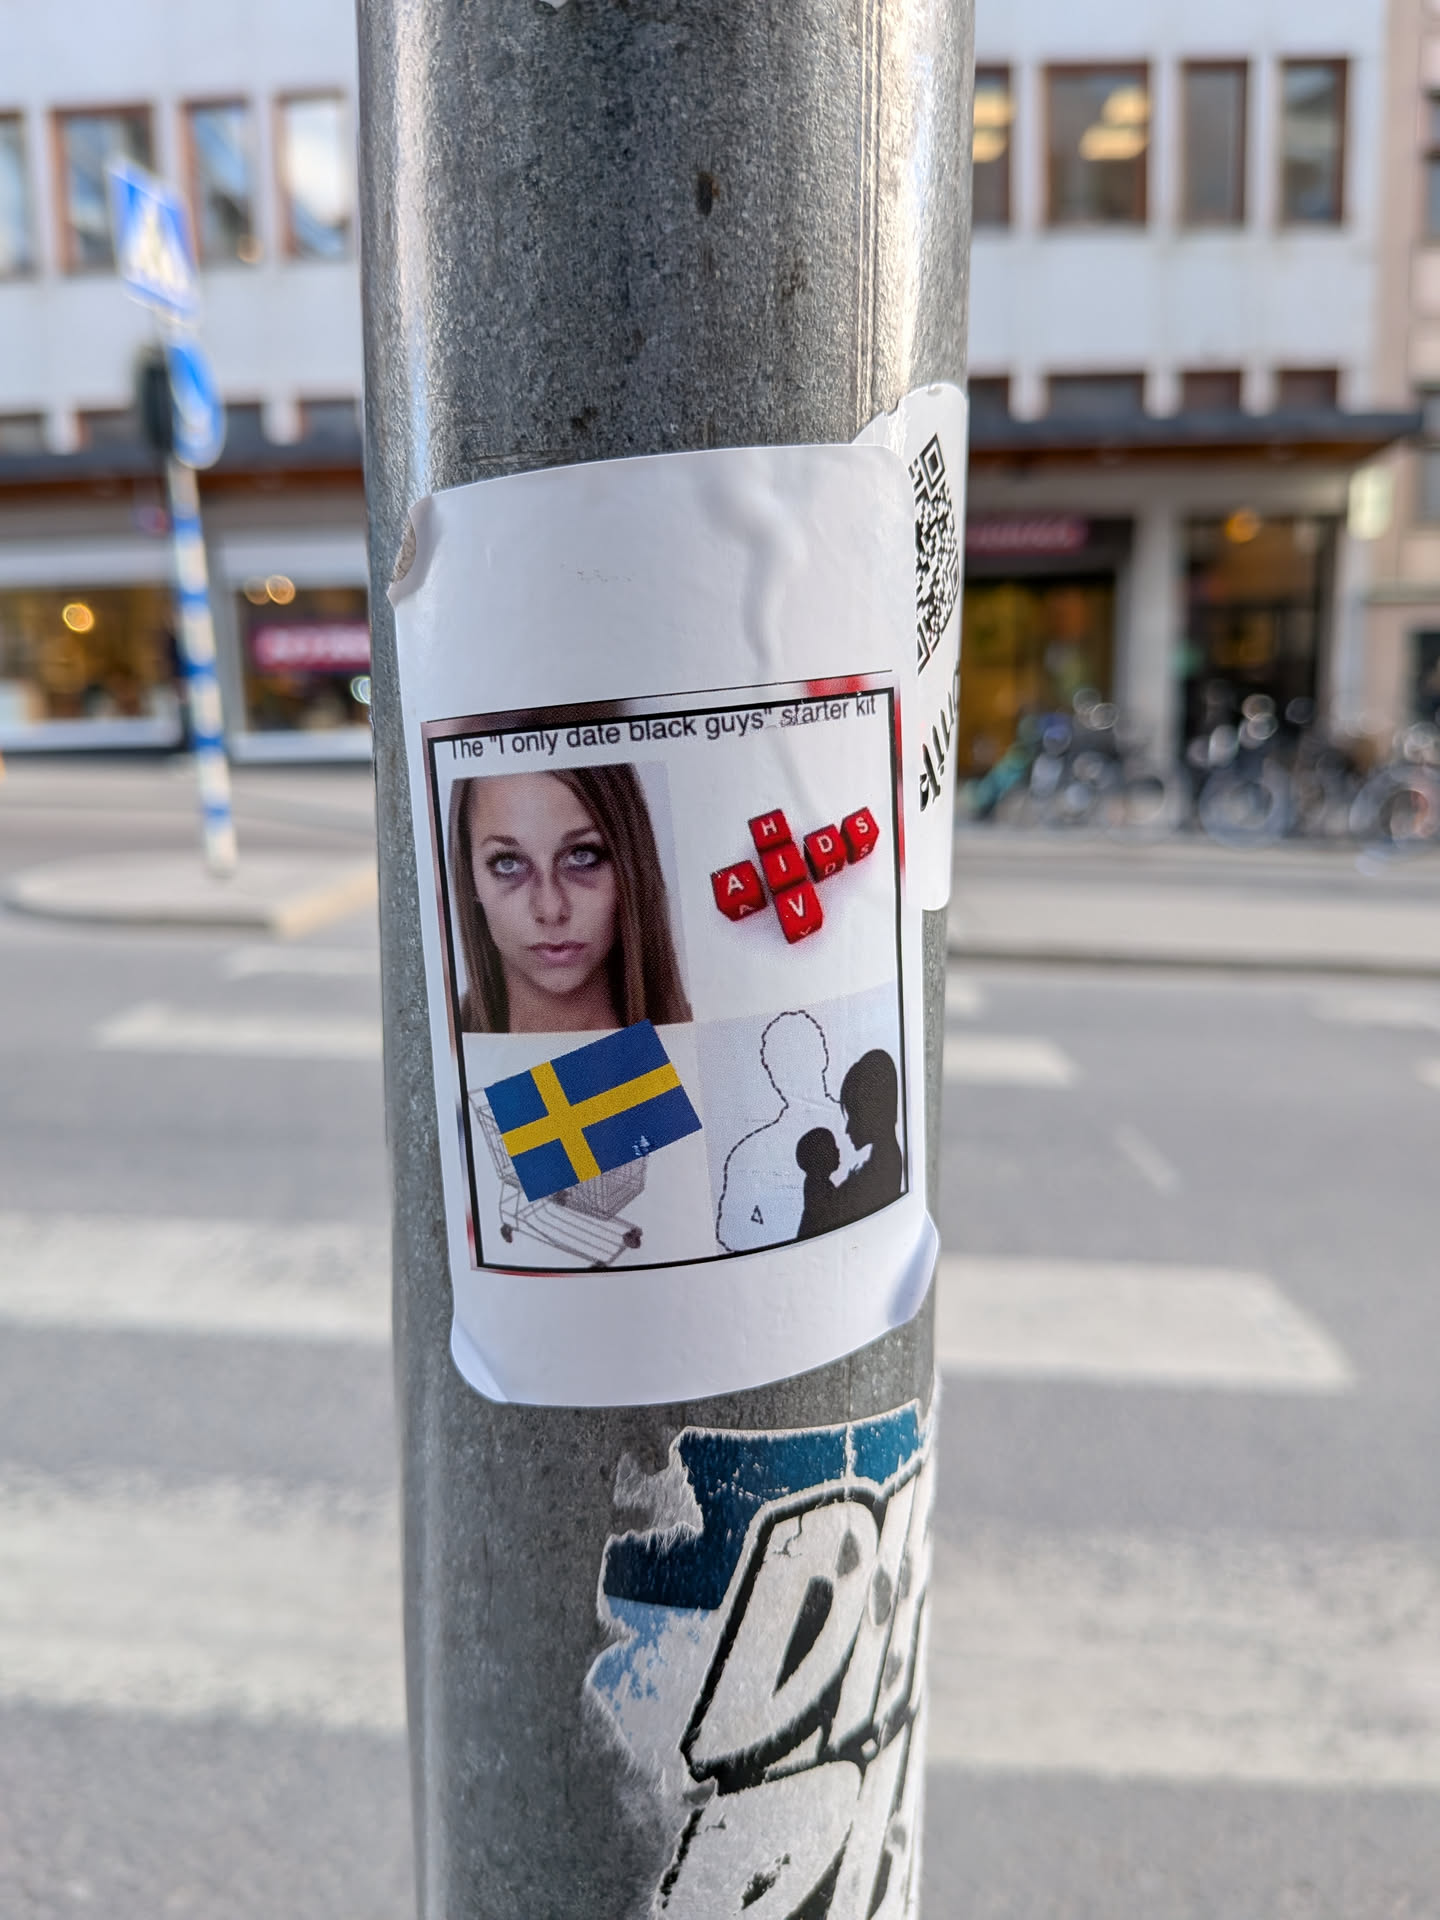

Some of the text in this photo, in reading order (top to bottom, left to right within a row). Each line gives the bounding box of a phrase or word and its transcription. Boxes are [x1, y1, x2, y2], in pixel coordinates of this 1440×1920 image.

[451, 738, 484, 760] The
[512, 730, 559, 756] only
[567, 724, 621, 749] date
[629, 716, 697, 741] black
[705, 708, 772, 740] guys"
[781, 700, 849, 722] starter
[855, 694, 876, 717] kit
